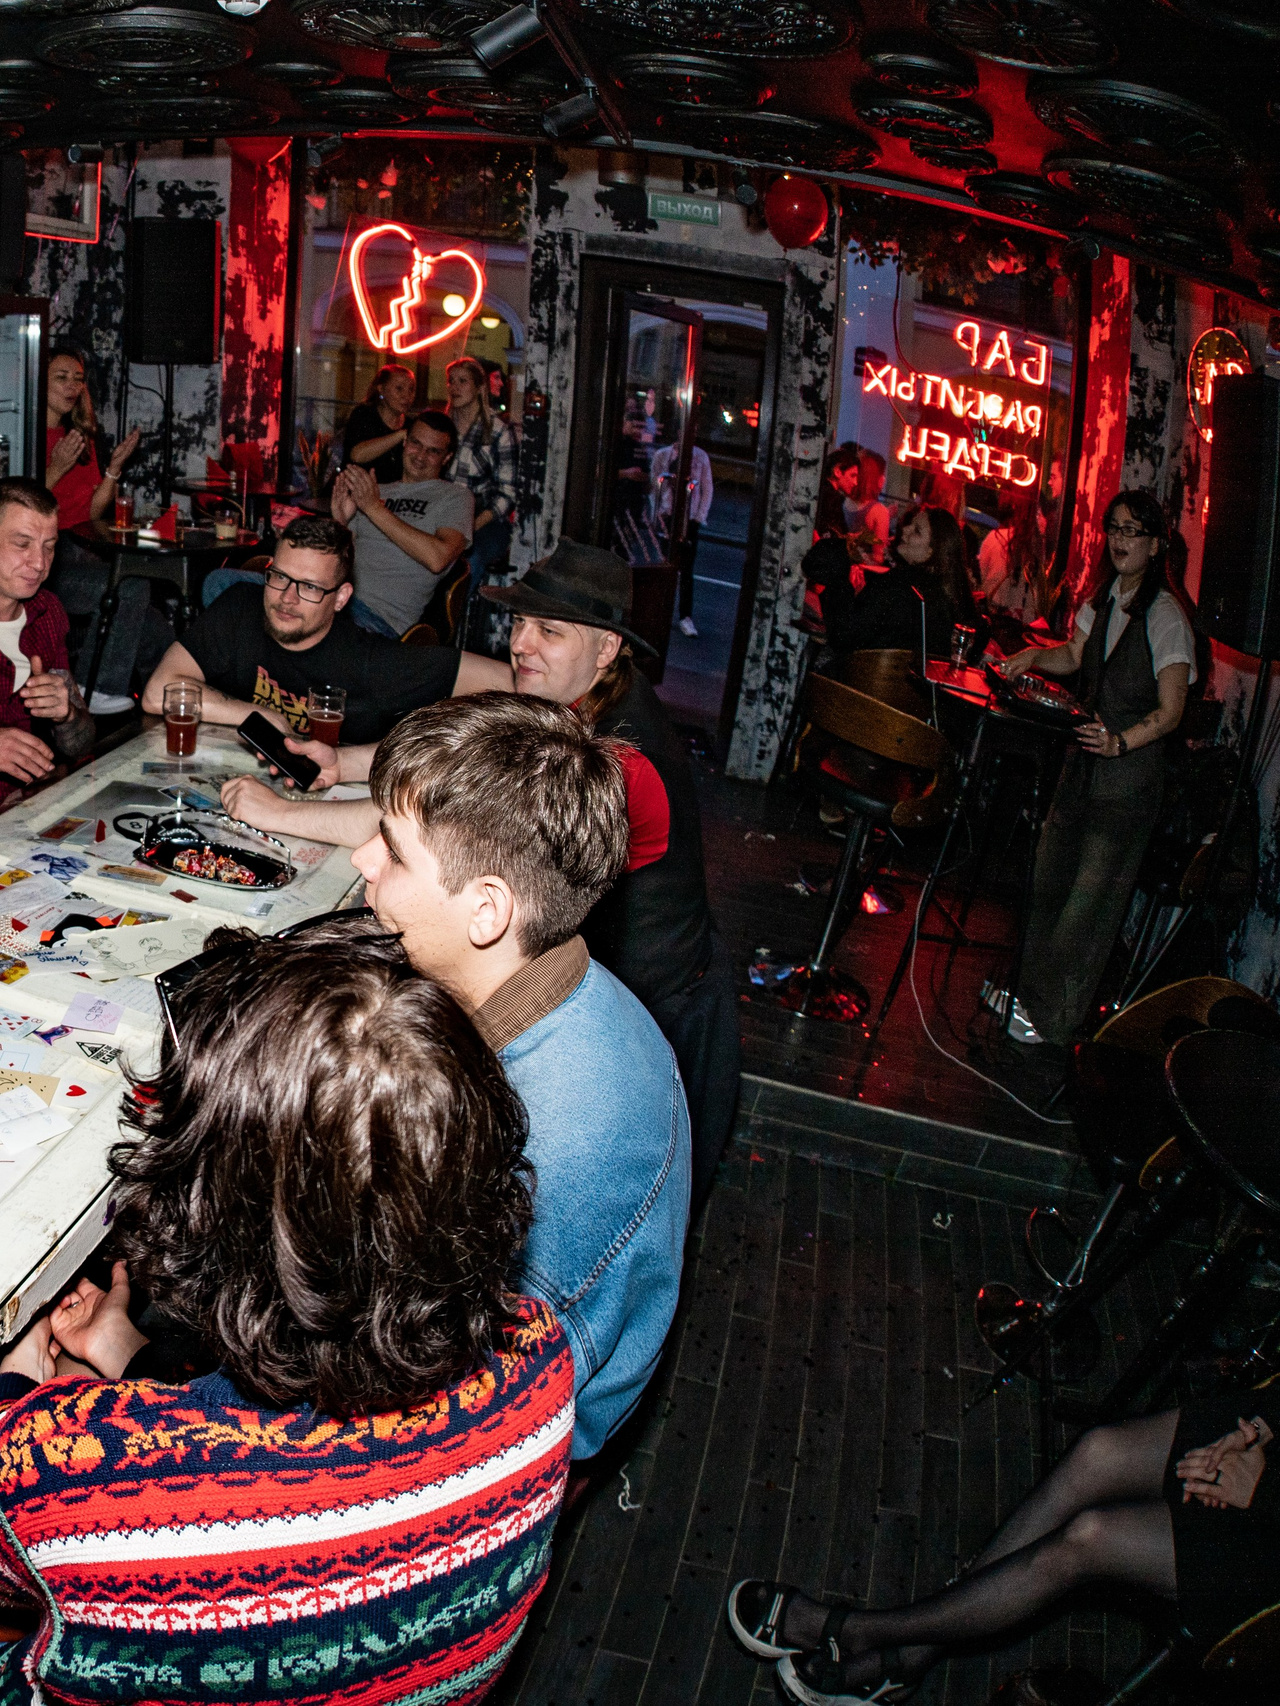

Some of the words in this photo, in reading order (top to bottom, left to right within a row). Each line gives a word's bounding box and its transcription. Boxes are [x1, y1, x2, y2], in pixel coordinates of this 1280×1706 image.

[657, 200, 714, 221] ВЫХОД
[385, 498, 429, 516] DIESEL
[254, 665, 308, 716] BACK
